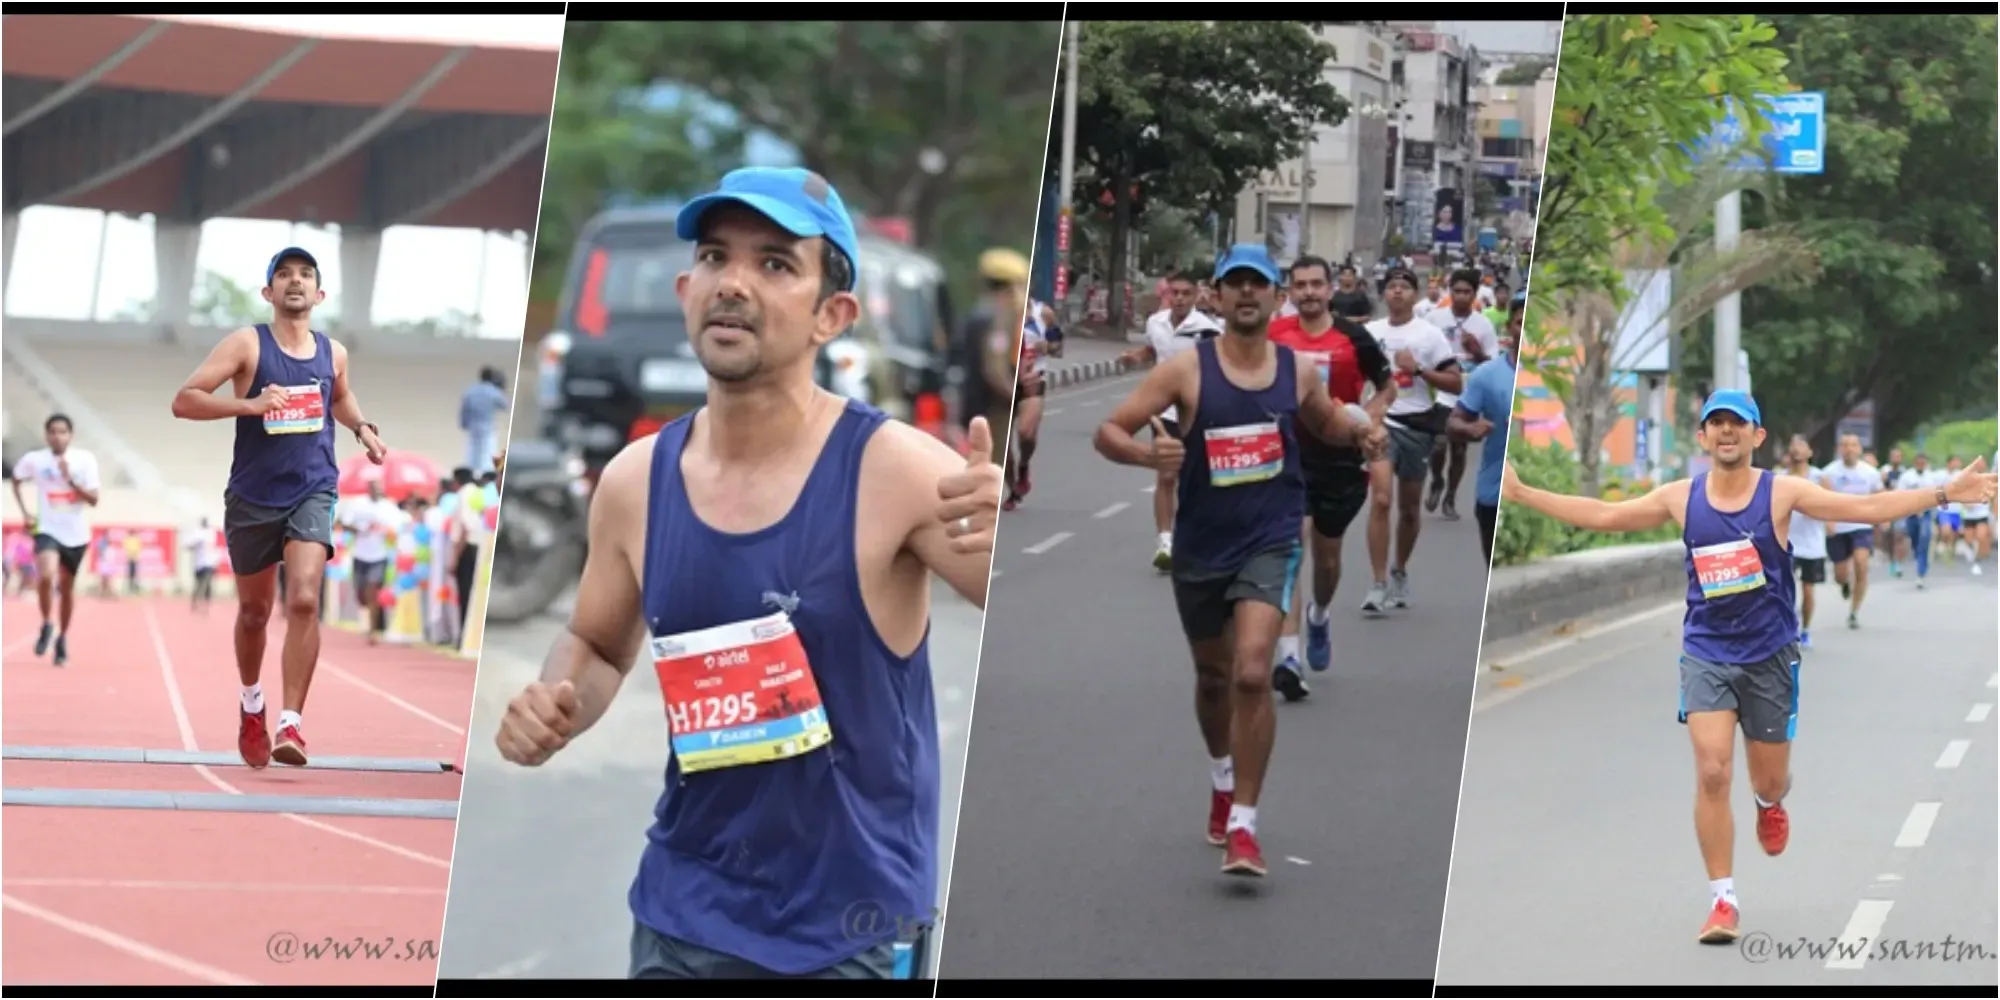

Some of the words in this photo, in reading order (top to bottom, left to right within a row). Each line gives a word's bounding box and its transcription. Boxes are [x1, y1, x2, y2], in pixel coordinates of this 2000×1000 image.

[264, 408, 306, 421] H1295
[1209, 452, 1263, 470] H1295
[1698, 566, 1740, 585] H1295
[717, 649, 750, 669] airtel
[668, 691, 758, 733] H1295
